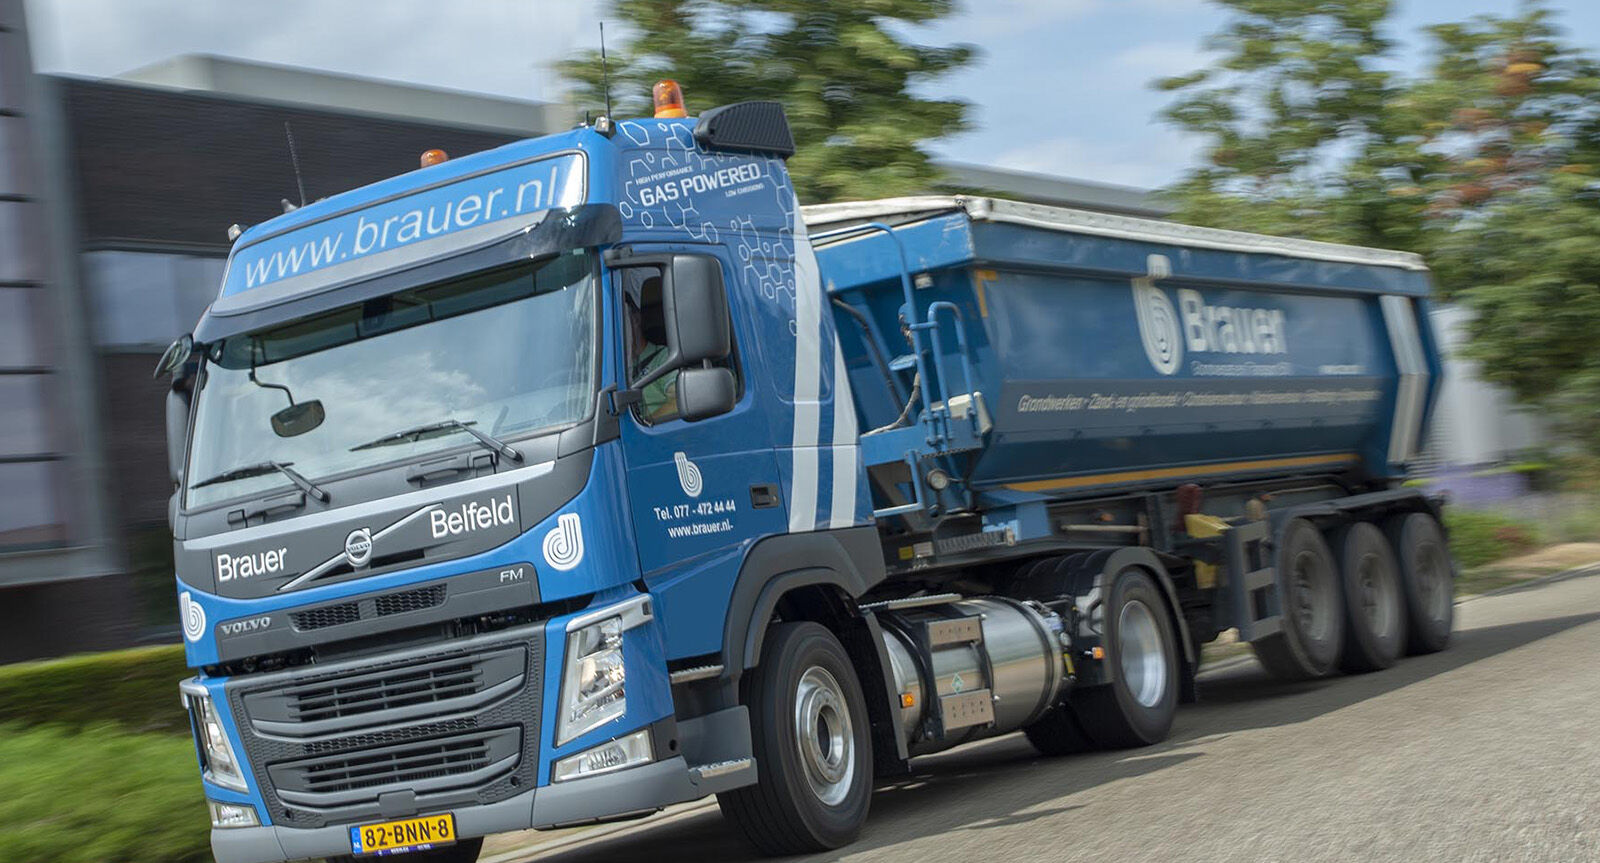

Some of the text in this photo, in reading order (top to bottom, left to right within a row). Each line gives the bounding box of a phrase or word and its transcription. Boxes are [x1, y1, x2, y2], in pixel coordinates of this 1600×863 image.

[640, 163, 761, 206] GAS POWERED
[246, 166, 557, 288] www.brauer.nl
[1177, 288, 1288, 354] Brauer
[430, 494, 515, 539] Belfeld
[654, 506, 673, 520] Tel.
[673, 504, 690, 519] 077
[697, 502, 713, 516] 472
[714, 500, 725, 513] 44
[726, 499, 736, 512] 44
[217, 547, 288, 582] Brauer
[500, 568, 524, 583] FM
[222, 616, 271, 635] VOLVO
[365, 819, 449, 848] 82-BNN-8
